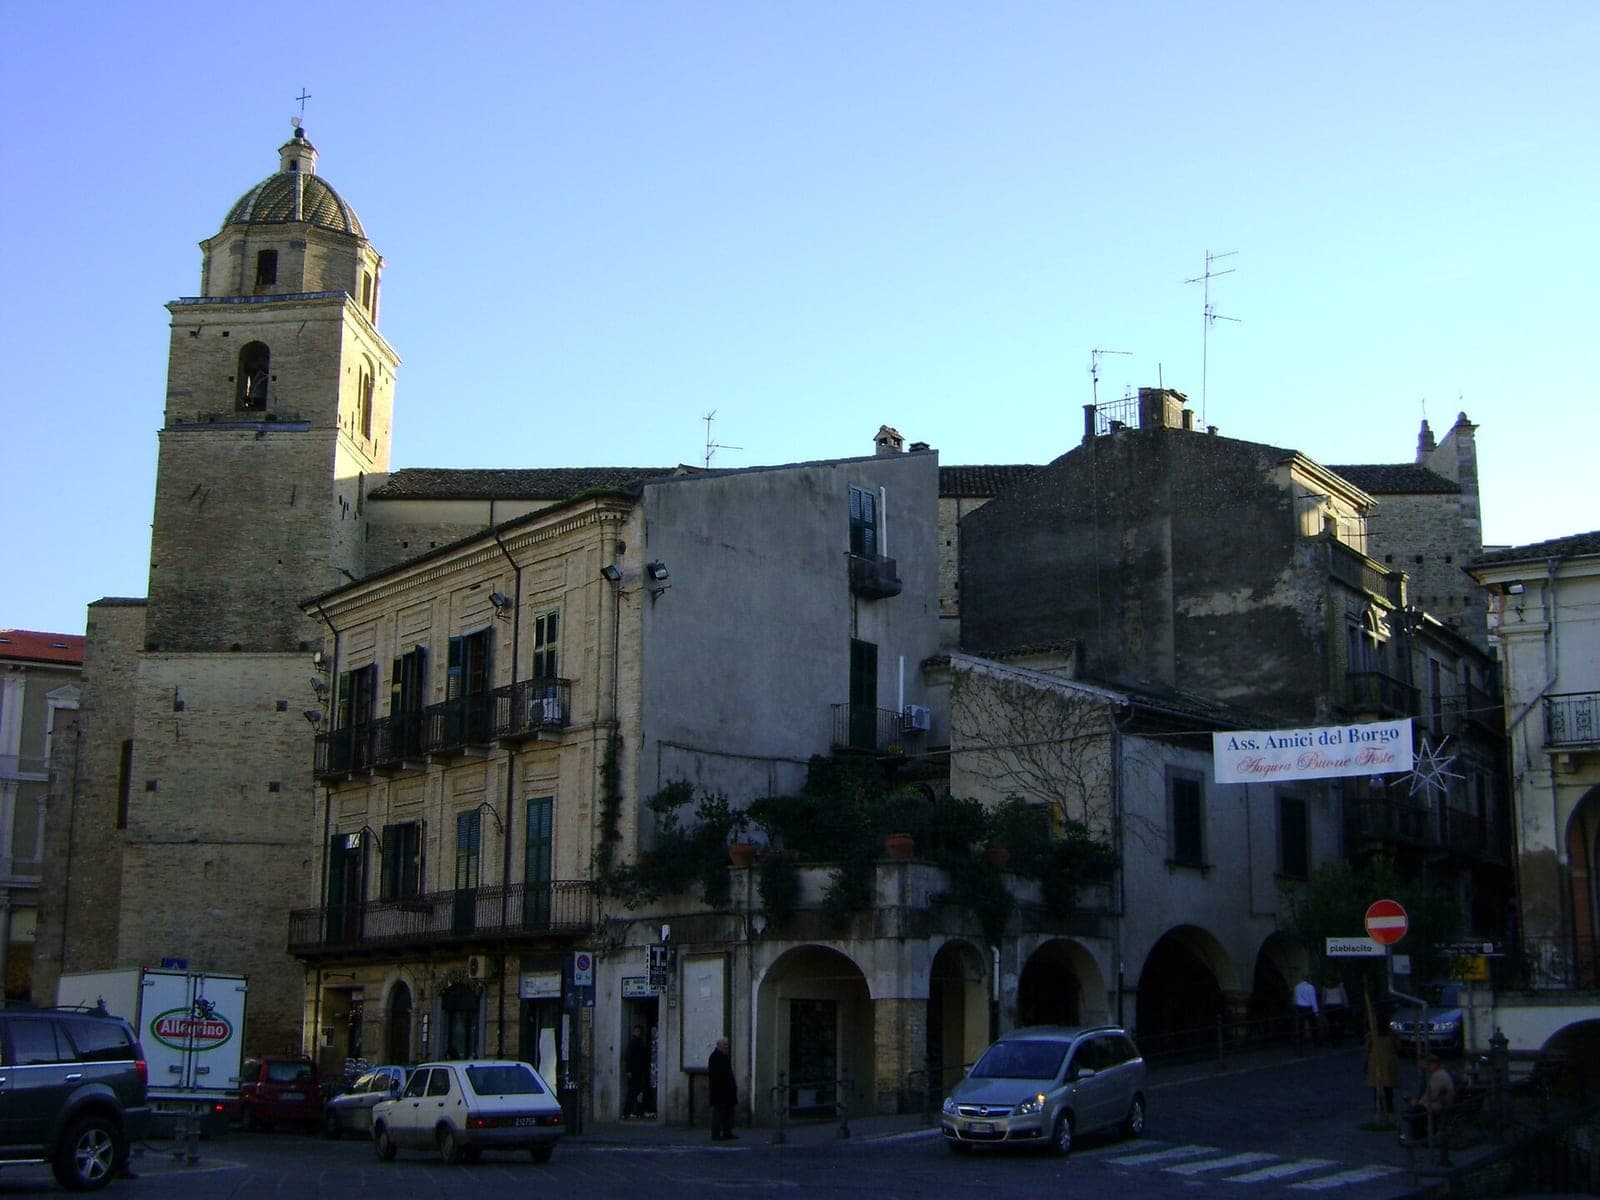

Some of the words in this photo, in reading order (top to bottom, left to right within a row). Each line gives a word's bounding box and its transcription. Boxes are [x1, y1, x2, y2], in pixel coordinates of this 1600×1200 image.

[1227, 737, 1260, 751] Ass.
[1264, 732, 1313, 749] Amici
[1319, 729, 1343, 746] del
[1349, 727, 1399, 744] Borgo
[1296, 751, 1351, 771] Buone
[1354, 747, 1396, 766] Feste
[1329, 944, 1373, 953] plebiscito
[159, 1019, 224, 1038] Allegrino
